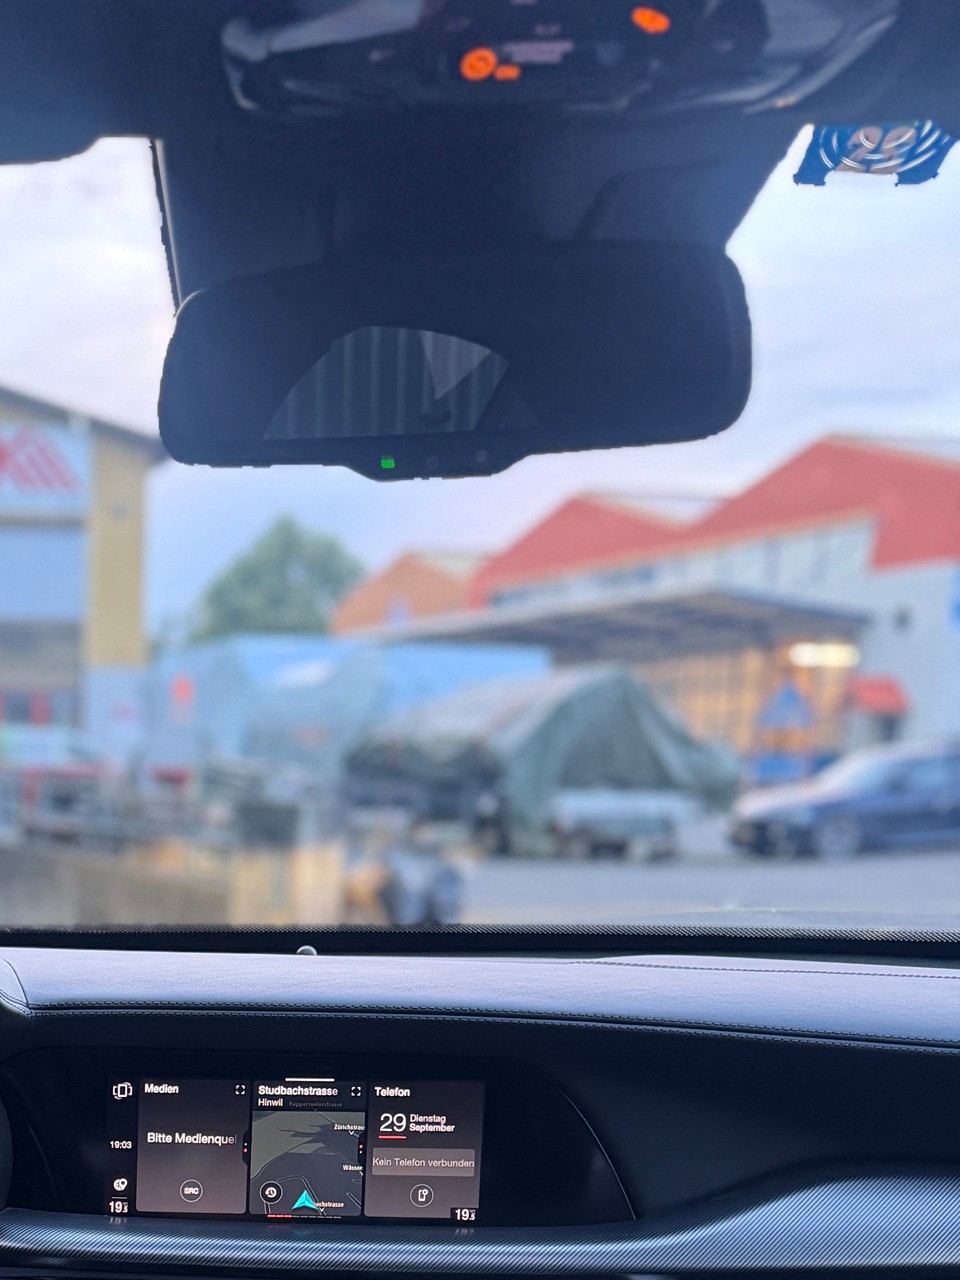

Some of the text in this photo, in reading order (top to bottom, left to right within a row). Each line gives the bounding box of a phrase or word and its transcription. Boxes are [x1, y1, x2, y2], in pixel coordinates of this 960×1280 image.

[144, 1083, 179, 1094] Medien
[258, 1085, 339, 1096] Studbachstrasse
[374, 1087, 411, 1097] Telefon
[258, 1098, 284, 1107] Hinwil
[379, 1113, 407, 1132] 29
[409, 1114, 446, 1124] Dienstag
[409, 1123, 455, 1133] September
[147, 1132, 172, 1143] Bitte
[110, 1141, 132, 1149] 19:03
[372, 1158, 475, 1168] Kein Telefon verbunden
[183, 1187, 199, 1195] SRC
